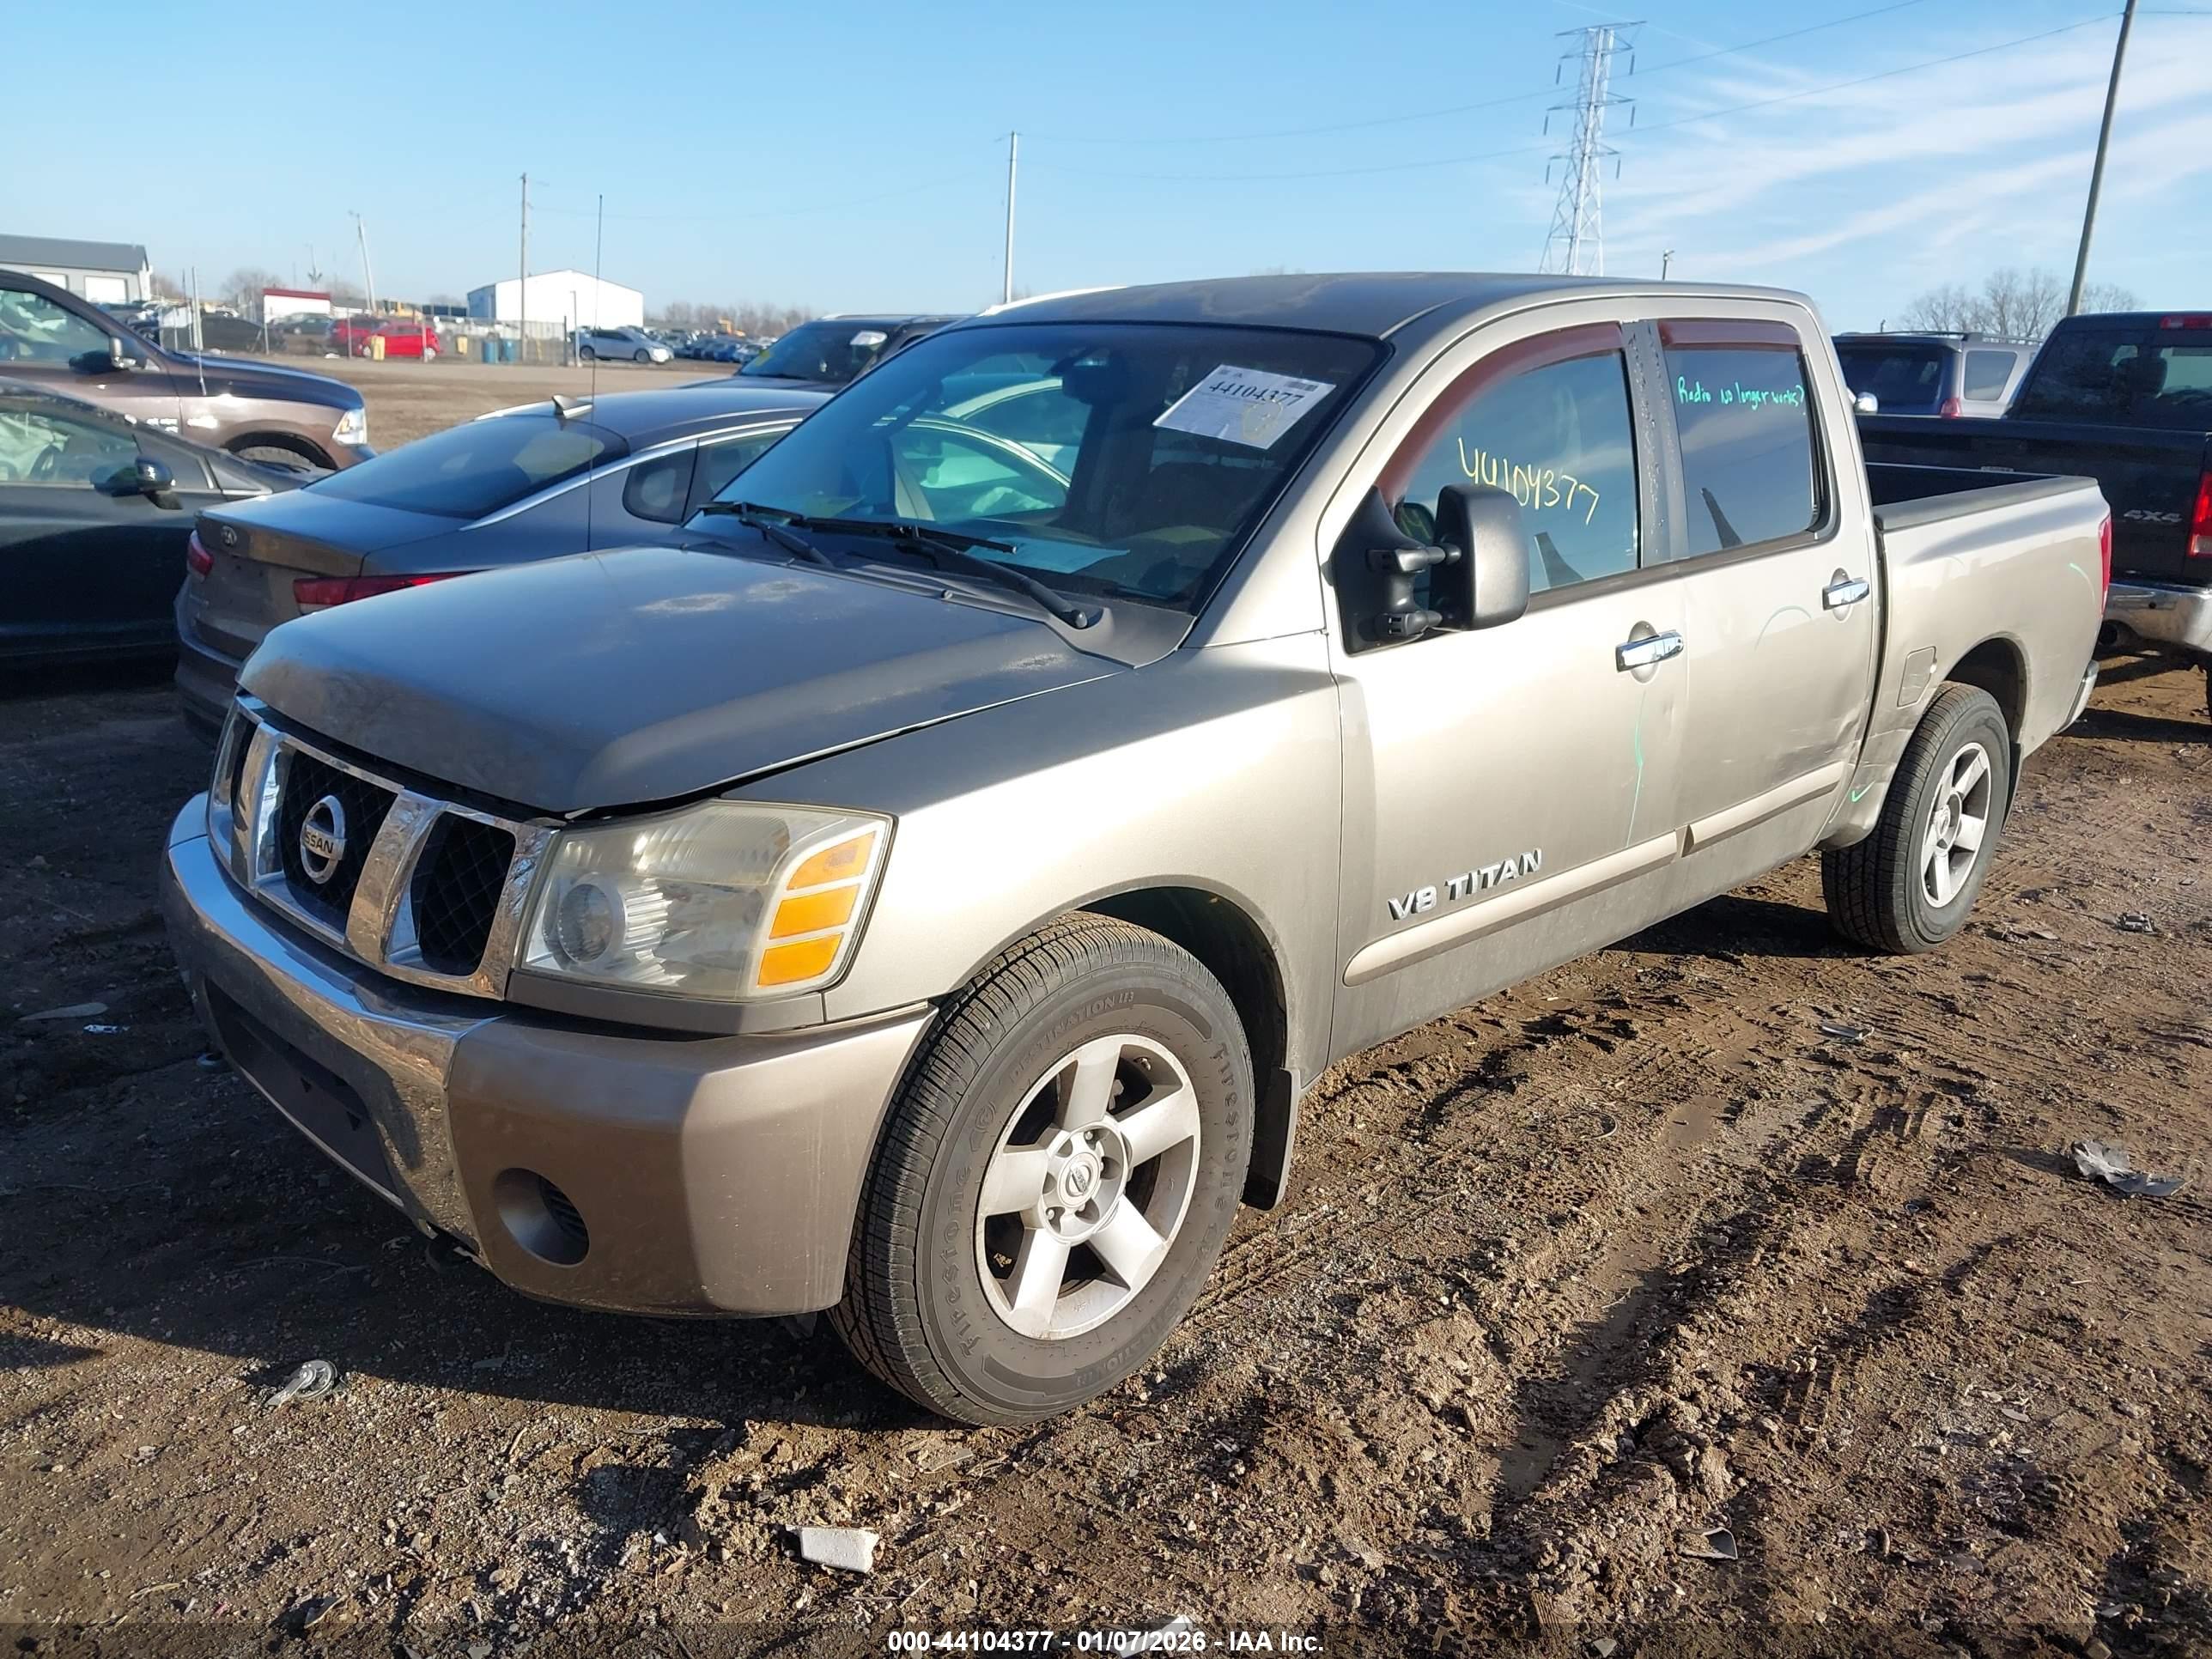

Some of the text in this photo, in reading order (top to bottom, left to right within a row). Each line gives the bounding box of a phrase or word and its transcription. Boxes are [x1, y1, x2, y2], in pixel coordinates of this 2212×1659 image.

[1209, 381, 1305, 406] 44104377
[1678, 376, 1711, 404] Radio
[1458, 437, 1600, 526] 44104377
[1388, 848, 1542, 921] V8 TITAN
[941, 1167, 981, 1357] Firestone
